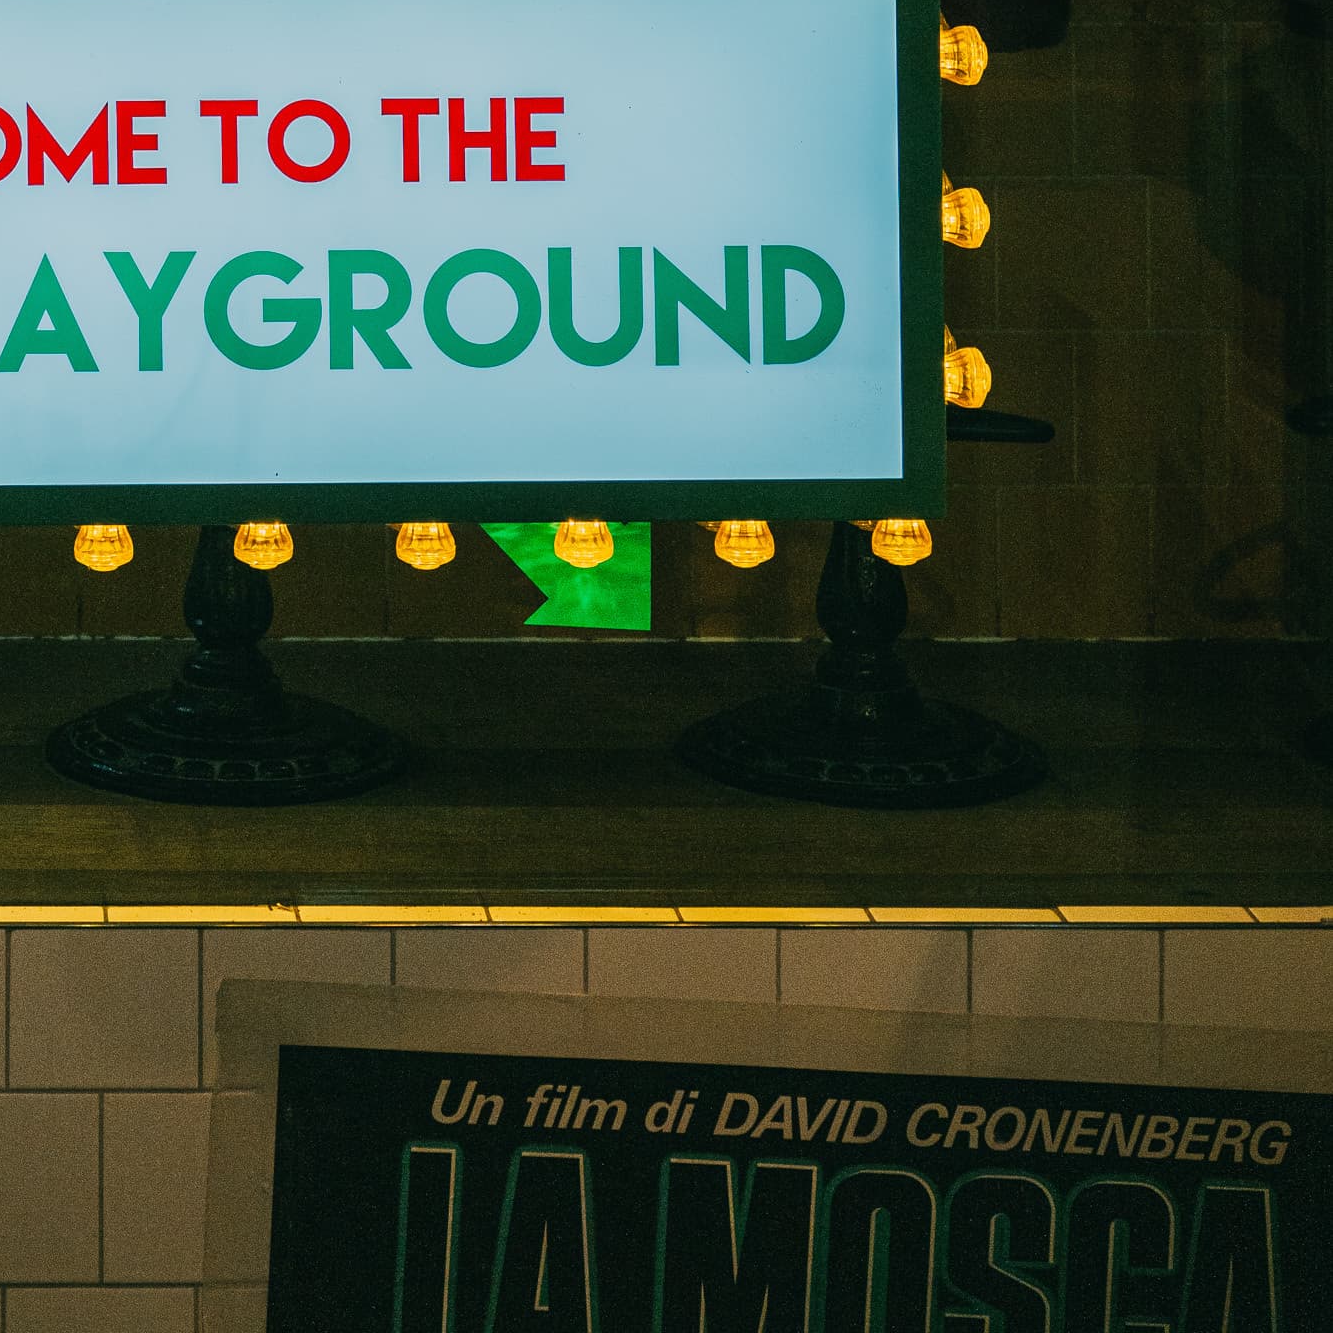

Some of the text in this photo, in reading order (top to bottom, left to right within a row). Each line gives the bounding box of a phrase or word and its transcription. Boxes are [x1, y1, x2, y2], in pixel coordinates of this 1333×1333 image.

[200, 100, 351, 184] TO
[382, 97, 565, 182] THE
[430, 1079, 1293, 1166] Un film di DAVID CRONENBERG
[654, 1152, 1280, 1333] MOSCA
